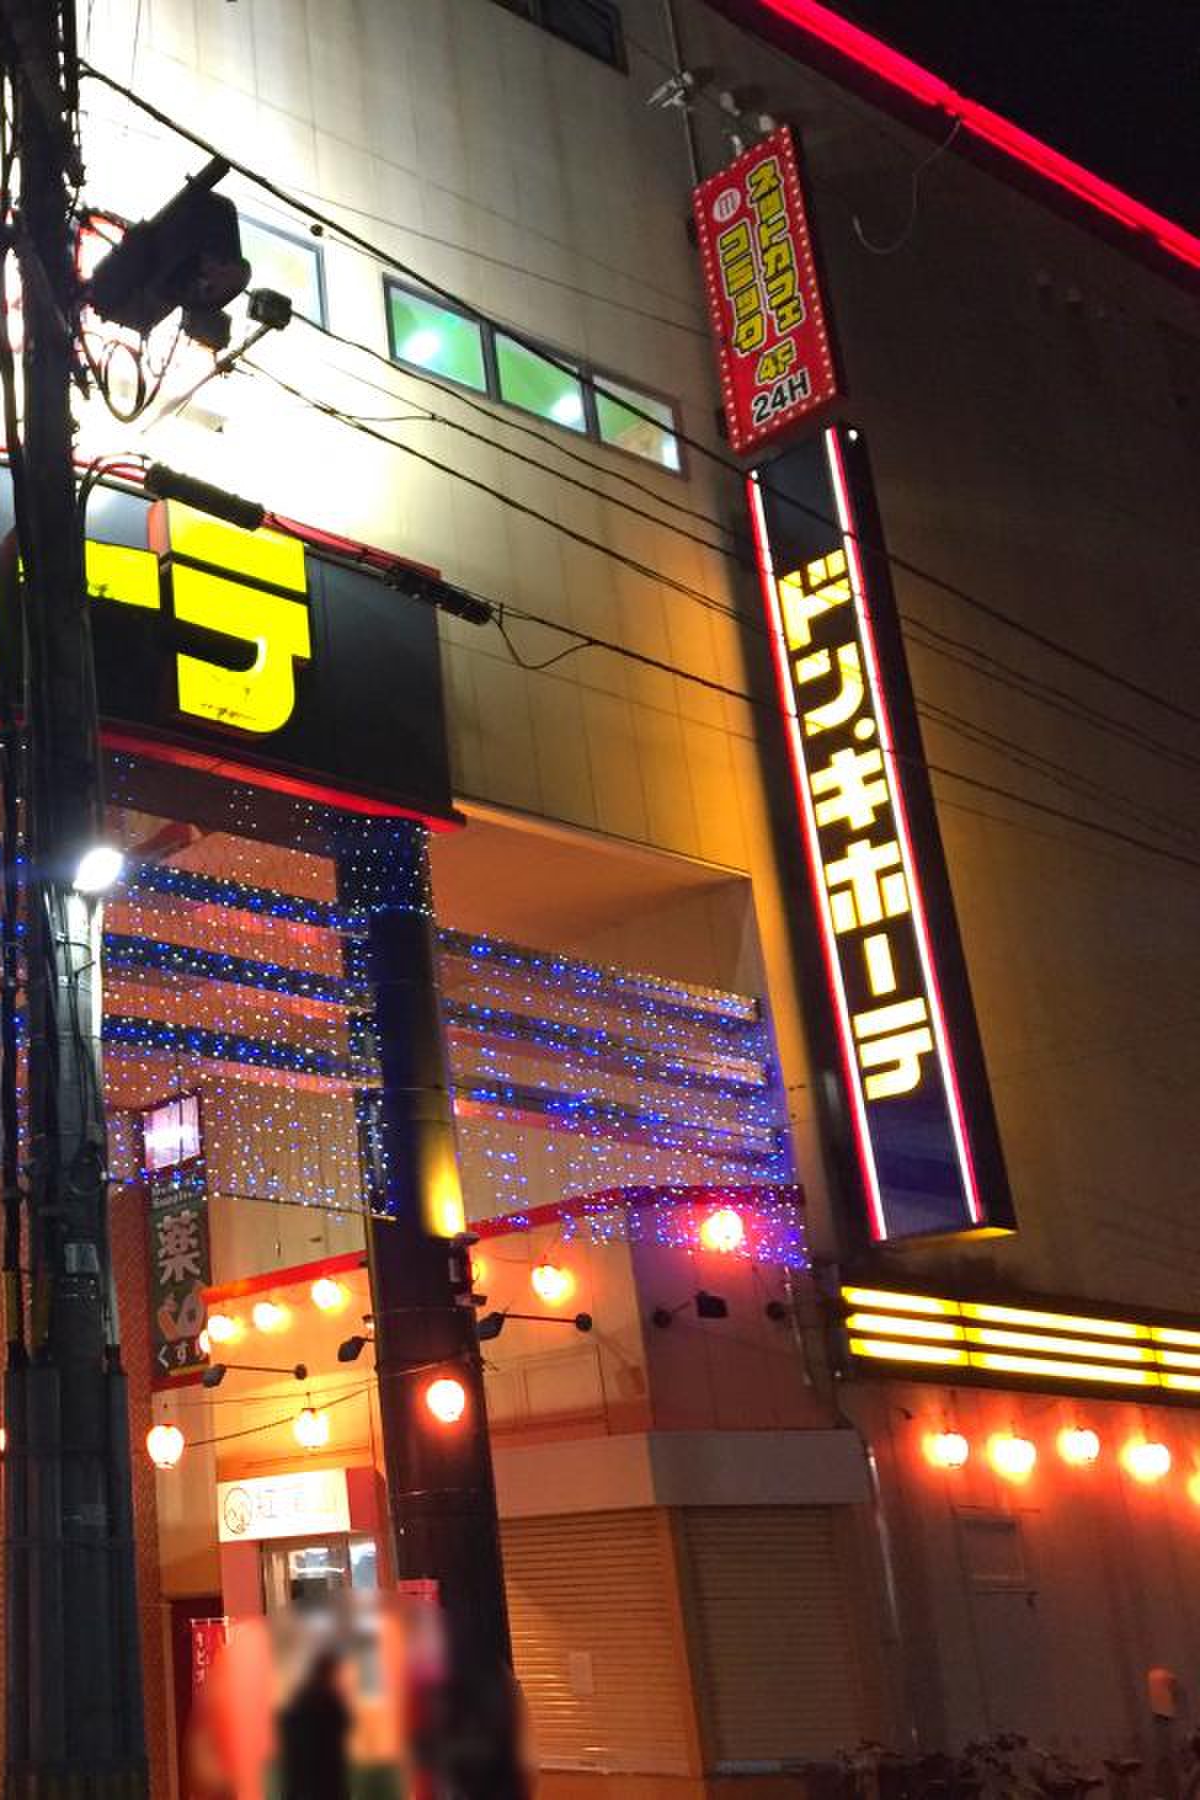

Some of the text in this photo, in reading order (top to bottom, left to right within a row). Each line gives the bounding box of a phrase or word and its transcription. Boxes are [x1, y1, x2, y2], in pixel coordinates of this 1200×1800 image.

[757, 340, 796, 384] 4F
[752, 370, 810, 424] 24H
[158, 1209, 201, 1283] 薬
